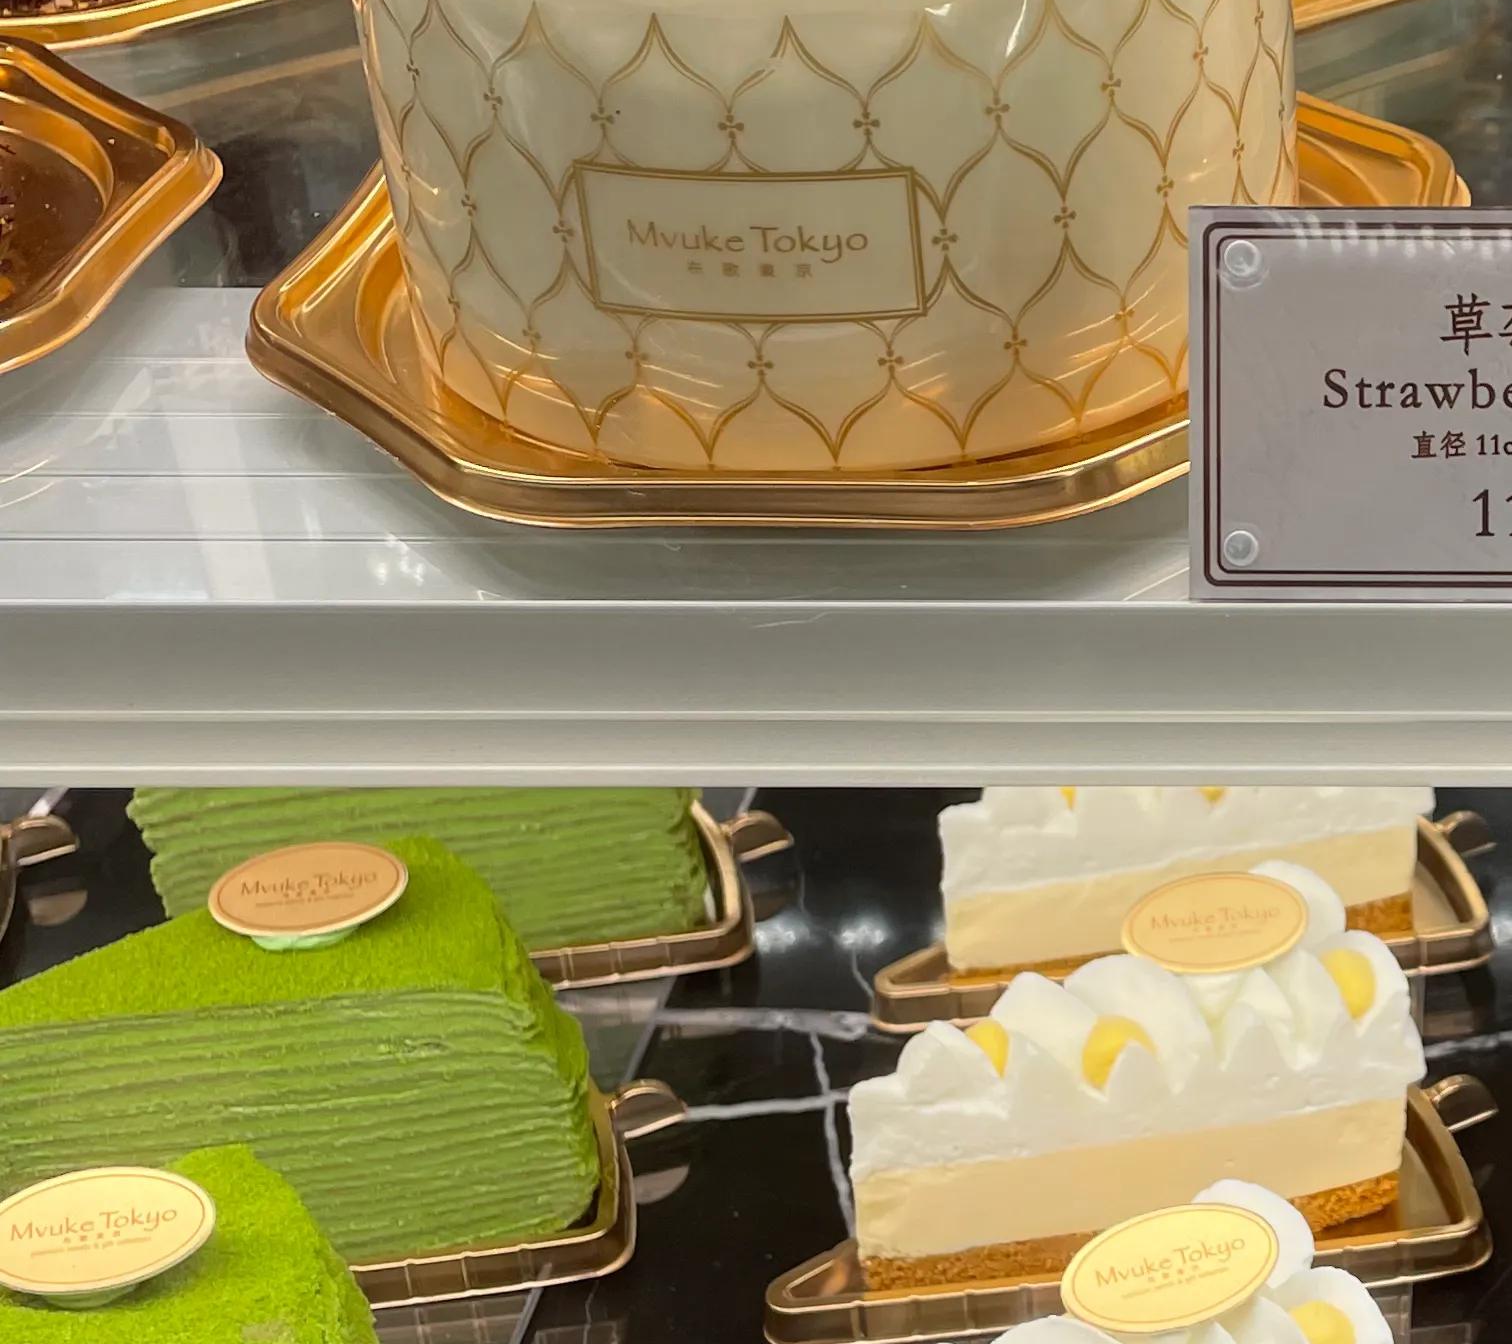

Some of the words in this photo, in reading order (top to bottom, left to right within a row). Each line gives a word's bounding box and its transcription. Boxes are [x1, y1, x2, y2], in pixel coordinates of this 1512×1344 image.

[627, 218, 745, 252] Mvuke
[749, 226, 869, 264] Tokyo
[11, 1217, 95, 1242] Mvuke
[99, 1207, 178, 1232] Tokyo
[1095, 1257, 1172, 1288] Mvuke
[1173, 1237, 1245, 1266] Tokyo
